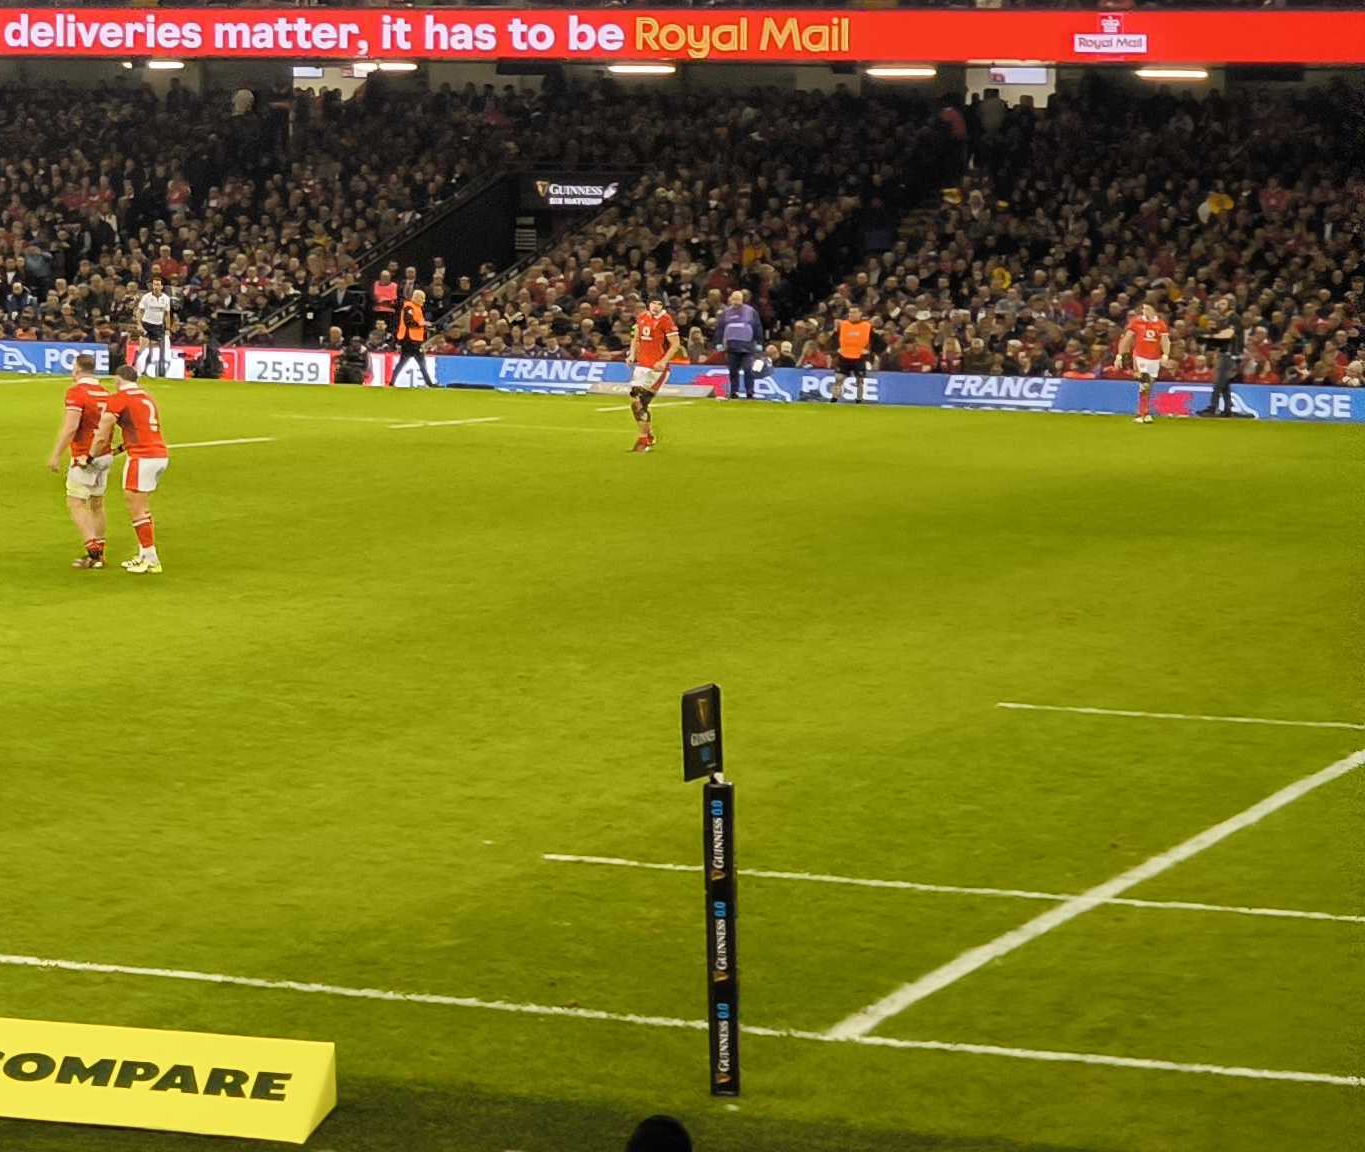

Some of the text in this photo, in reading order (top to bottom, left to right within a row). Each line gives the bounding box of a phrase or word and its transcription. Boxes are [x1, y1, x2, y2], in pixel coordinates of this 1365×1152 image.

[4, 14, 202, 50] deliveries
[214, 17, 370, 55] matter,
[381, 14, 412, 50] it
[424, 14, 497, 50] has
[507, 18, 555, 51] to
[569, 15, 625, 51] be
[635, 16, 748, 58] Royal
[759, 17, 851, 52] Mail
[1077, 37, 1142, 51] Royal Mail
[549, 183, 605, 196] GUINNESS
[45, 348, 109, 371] POE
[256, 360, 319, 382] 25:59
[499, 359, 607, 382] FRANCE
[944, 376, 1062, 399] FRANCE
[1270, 393, 1352, 418] POSE
[712, 817, 725, 869] GUINNESS
[715, 918, 728, 970] GUINNESS
[717, 1020, 730, 1072] GUINNESS
